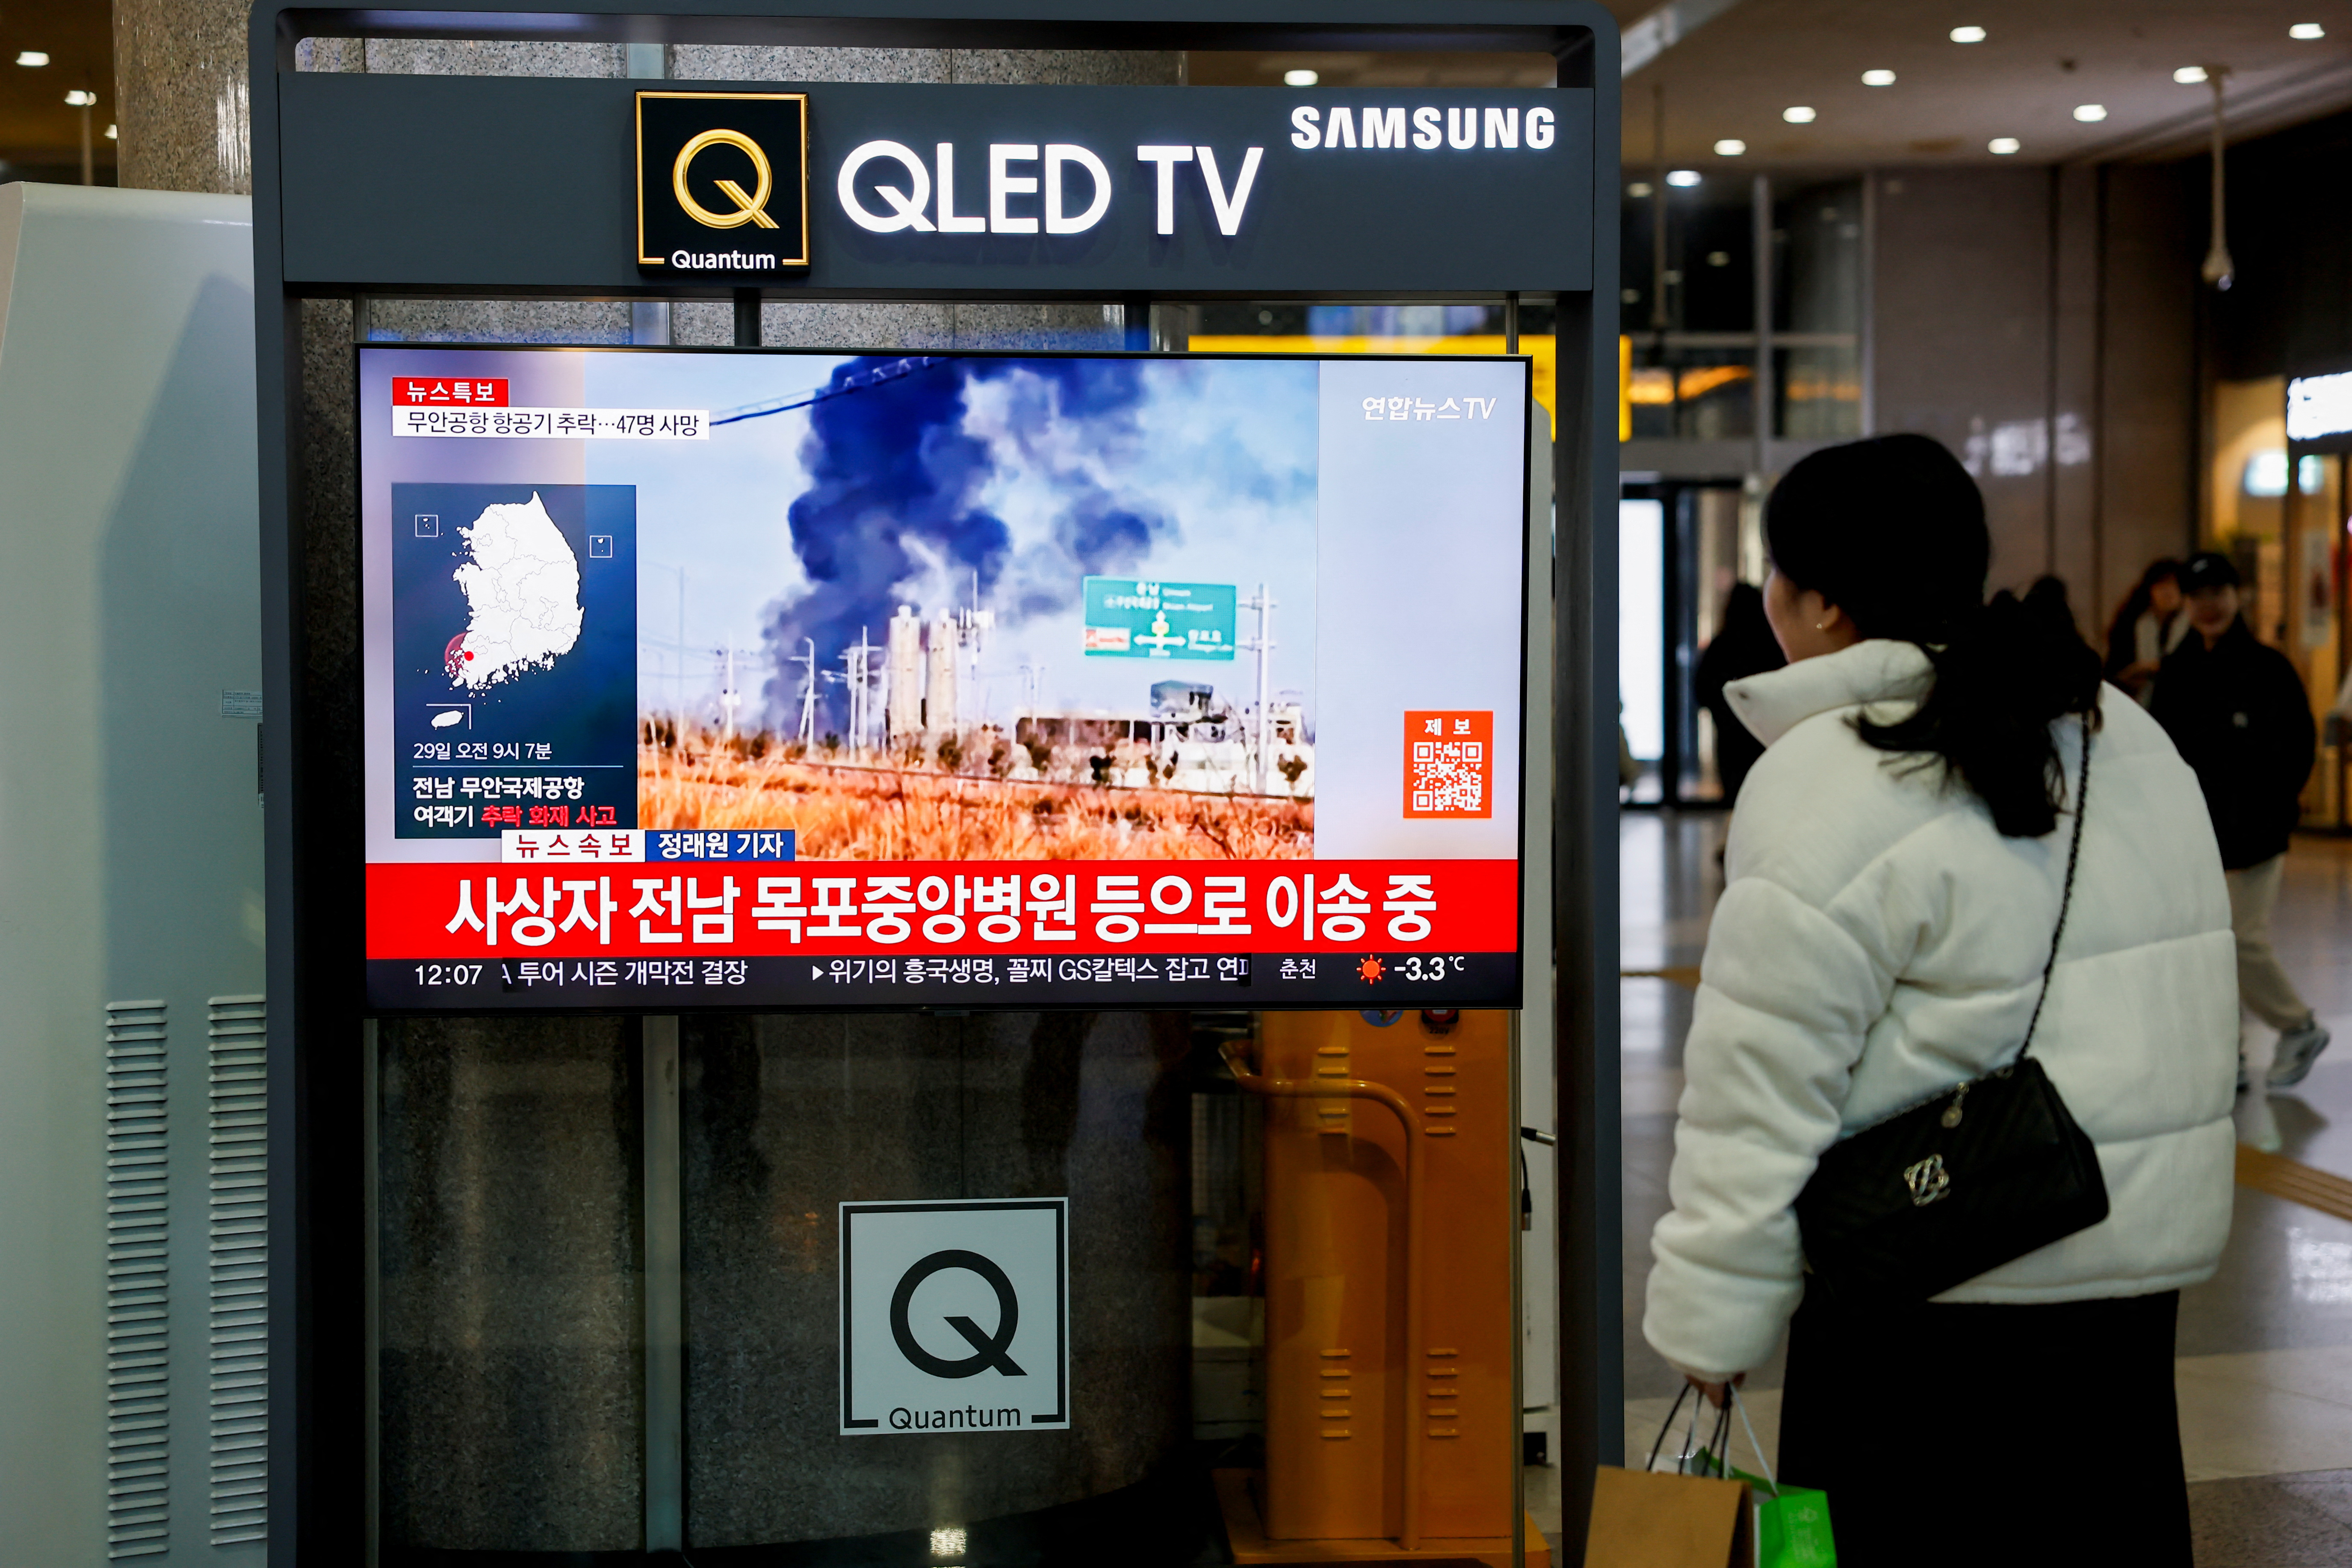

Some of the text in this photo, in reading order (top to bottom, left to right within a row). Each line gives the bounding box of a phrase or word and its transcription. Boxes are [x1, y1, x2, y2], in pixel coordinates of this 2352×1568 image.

[1291, 106, 1554, 150] SAMSUNG
[673, 129, 780, 229] Q
[838, 140, 1264, 236] QLED TV
[672, 249, 775, 270] Quantum
[407, 381, 496, 403] 뉴스특보
[1362, 396, 1497, 421] 연합뉴스TV
[407, 411, 489, 434] 무안공항
[493, 411, 552, 435] 항공기
[659, 415, 699, 437] 사망
[414, 742, 553, 760] 29일 오전 9시 7분
[413, 776, 585, 800] 전남 무안국제공항
[414, 805, 617, 827] 여객기 추락 화재 사고
[516, 832, 784, 859] 뉴스속보 정래원 기자
[445, 873, 1437, 946] 사상자 전남 목포중앙병원 등으로 이송 중
[414, 964, 483, 986] 12:07
[517, 961, 563, 986] 투어
[571, 961, 618, 986] 시즌
[625, 960, 694, 985] 개막전
[701, 960, 748, 985] 결장
[829, 959, 896, 984] 위기의
[902, 957, 1000, 985] 흥국생명,
[1006, 957, 1052, 983] 꼴찌
[1059, 957, 1158, 982] GS칼텍스
[1165, 957, 1210, 982] 잡고
[1279, 958, 1316, 980] 춘천
[890, 1249, 1028, 1379] Q
[889, 1405, 1021, 1430] Quantum
